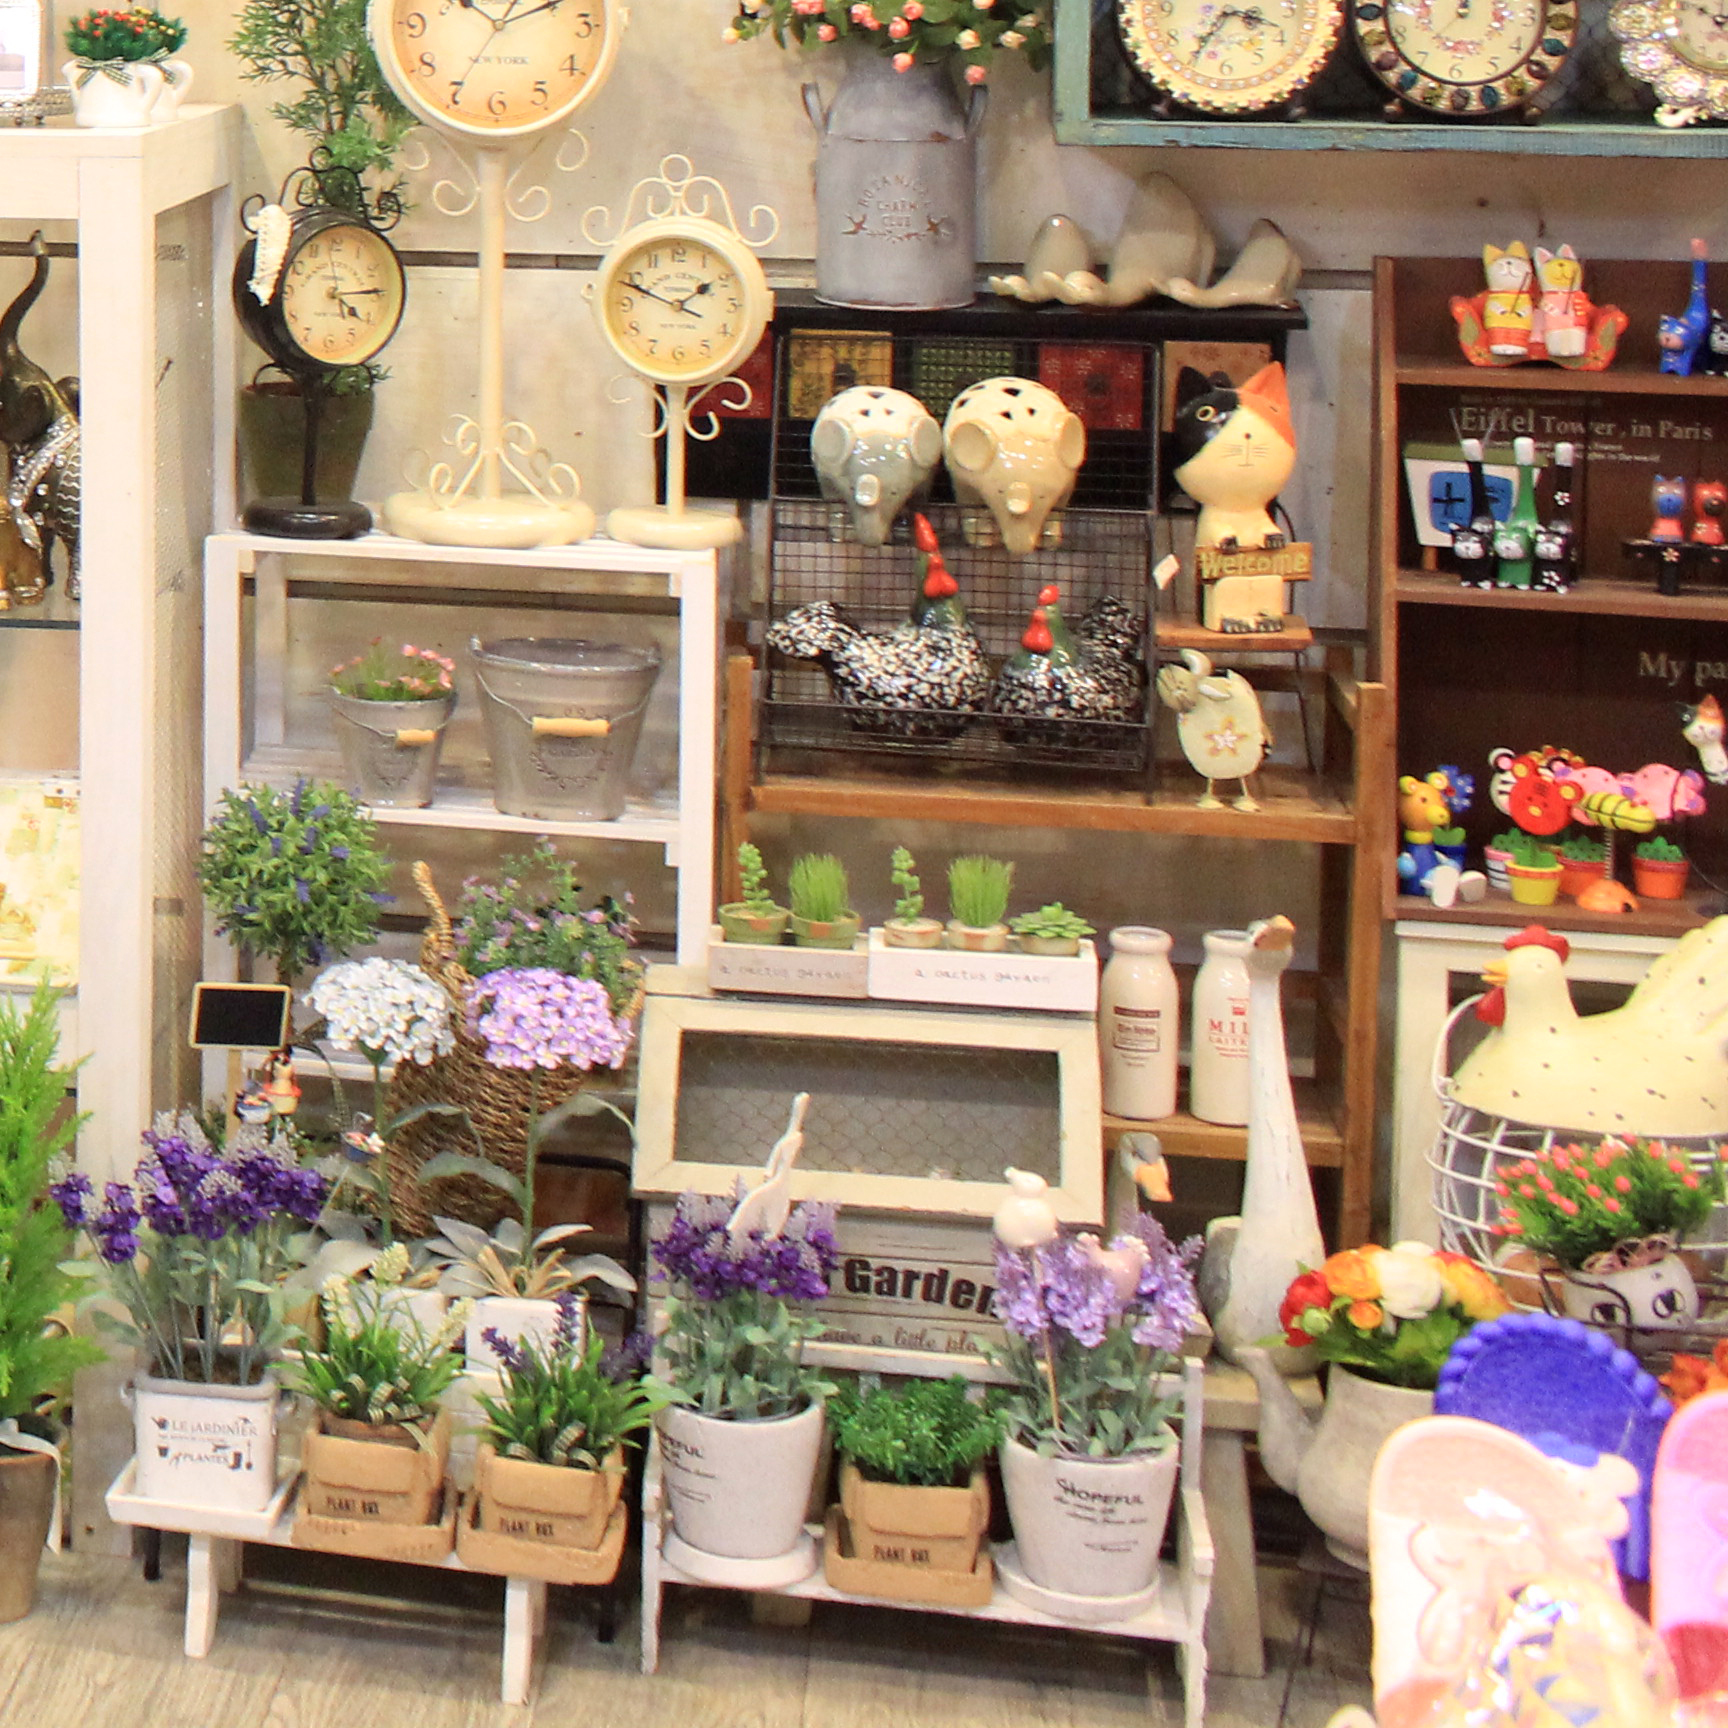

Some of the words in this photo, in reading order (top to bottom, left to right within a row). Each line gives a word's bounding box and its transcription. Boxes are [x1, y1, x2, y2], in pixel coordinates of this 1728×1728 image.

[406, 12, 427, 38] 9
[575, 12, 593, 38] 3
[418, 51, 436, 77] 8
[469, 56, 492, 65] NEW
[497, 56, 529, 65] YORK
[559, 54, 580, 76] 4
[449, 80, 464, 106] 7
[488, 91, 507, 115] 6
[531, 80, 548, 106] 5
[1461, 407, 1535, 433] Eiffel
[1630, 419, 1652, 438] in
[1659, 420, 1714, 441] Paris
[1200, 550, 1310, 580] Welcome
[1639, 651, 1684, 686] My
[1208, 1018, 1248, 1034] MIL
[844, 1257, 999, 1319] Garden
[327, 1496, 356, 1513] PLANT
[362, 1500, 380, 1516] BOX
[500, 1517, 531, 1533] PLANT
[535, 1521, 554, 1537] BOX
[874, 1544, 905, 1562] PLANT
[912, 1549, 930, 1563] BOX
